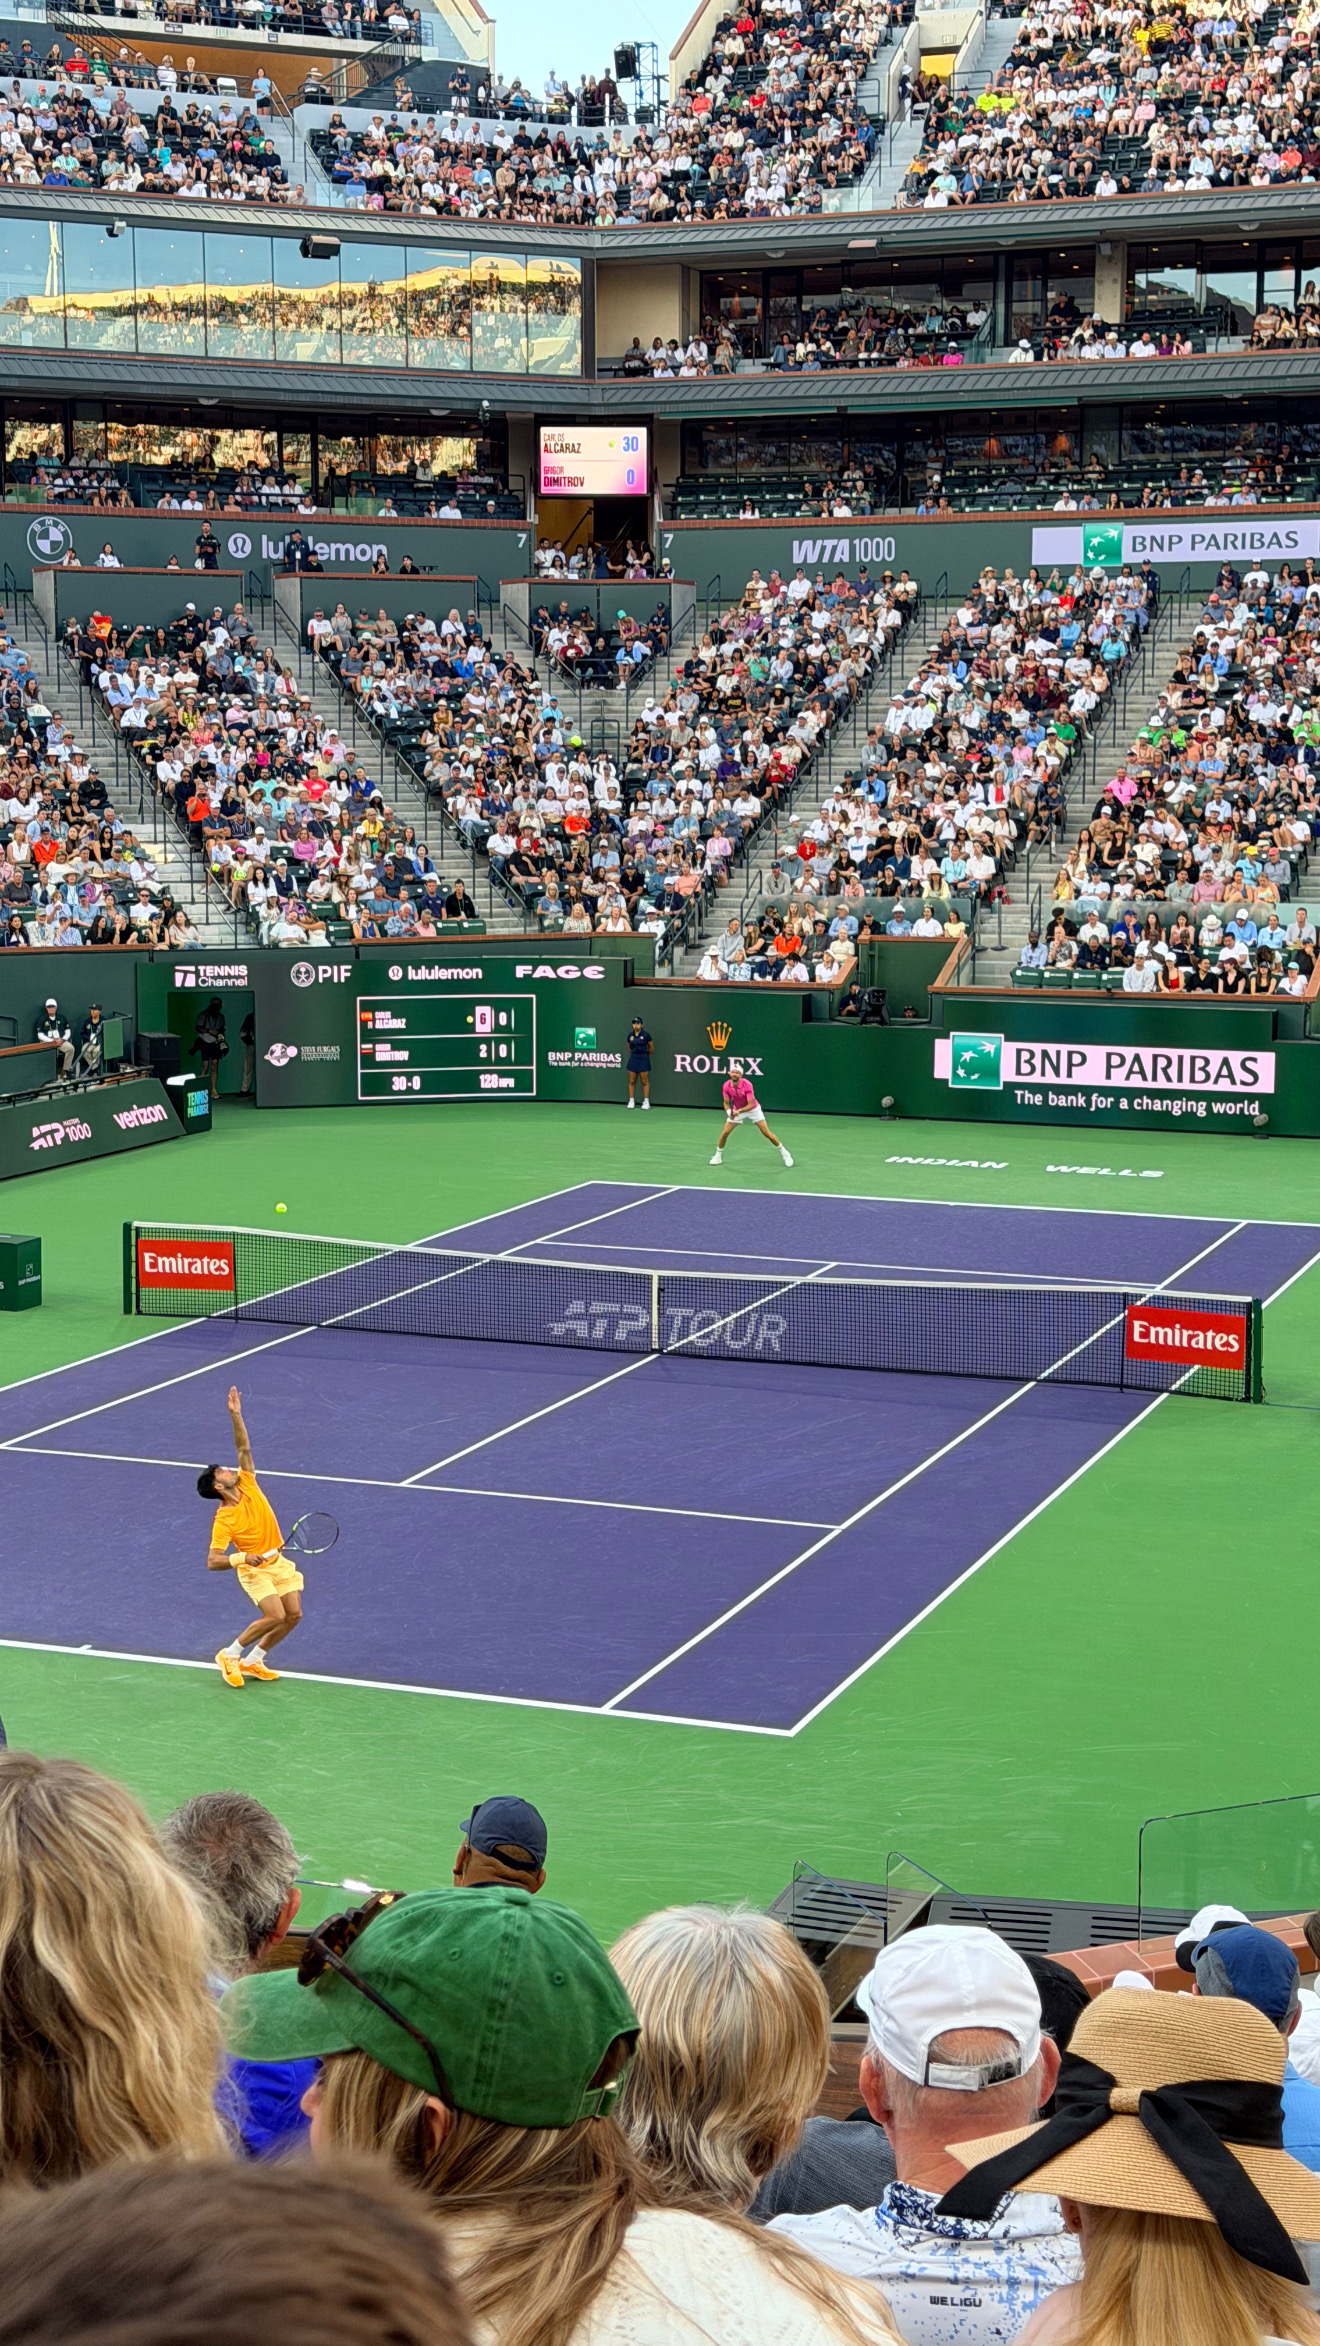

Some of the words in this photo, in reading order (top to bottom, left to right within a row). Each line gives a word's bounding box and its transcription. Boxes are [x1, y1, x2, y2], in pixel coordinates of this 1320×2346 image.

[543, 442, 582, 454] ALCARAZ
[622, 435, 639, 452] 30
[543, 475, 585, 488] DIMITROV
[626, 469, 635, 486] 0
[261, 534, 388, 562] lullemon
[516, 533, 527, 549] 7
[663, 533, 674, 549] 7
[792, 538, 850, 565] WTA
[853, 536, 896, 563] 1000
[1131, 534, 1183, 553] BNP
[1190, 530, 1300, 551] PARIBAS
[197, 965, 248, 977] TENNIS
[317, 965, 353, 984] PIF
[407, 965, 483, 981] lululemon
[197, 976, 248, 988] Channel
[375, 1018, 407, 1029] ALCARAZ
[479, 1012, 487, 1025] 6
[498, 1011, 507, 1026] 0
[375, 1051, 410, 1062] DIMITROV
[479, 1044, 488, 1058] 2
[498, 1044, 507, 1058] 0
[547, 1052, 573, 1061] BNP
[574, 1052, 622, 1062] PARIBAS
[673, 1054, 765, 1076] ROLEX
[1014, 1047, 1088, 1079] BNP
[1105, 1051, 1260, 1087] PARIBAS
[1014, 1089, 1043, 1106] The
[1048, 1091, 1087, 1108] bank
[1089, 1093, 1115, 1112] for
[1119, 1097, 1129, 1110] a
[1133, 1096, 1207, 1118] changing
[1211, 1100, 1260, 1116] world
[113, 1104, 169, 1130] verizon
[28, 1122, 66, 1151] ATP
[65, 1122, 92, 1142] 1000
[885, 1156, 1009, 1169] INDIAN
[1046, 1164, 1165, 1178] WELLS
[143, 1252, 230, 1276] Emirates
[543, 1300, 650, 1340] ATP
[666, 1307, 787, 1351] TOUR
[1132, 1320, 1240, 1353] Emirates
[929, 2295, 983, 2308] WELIGU
